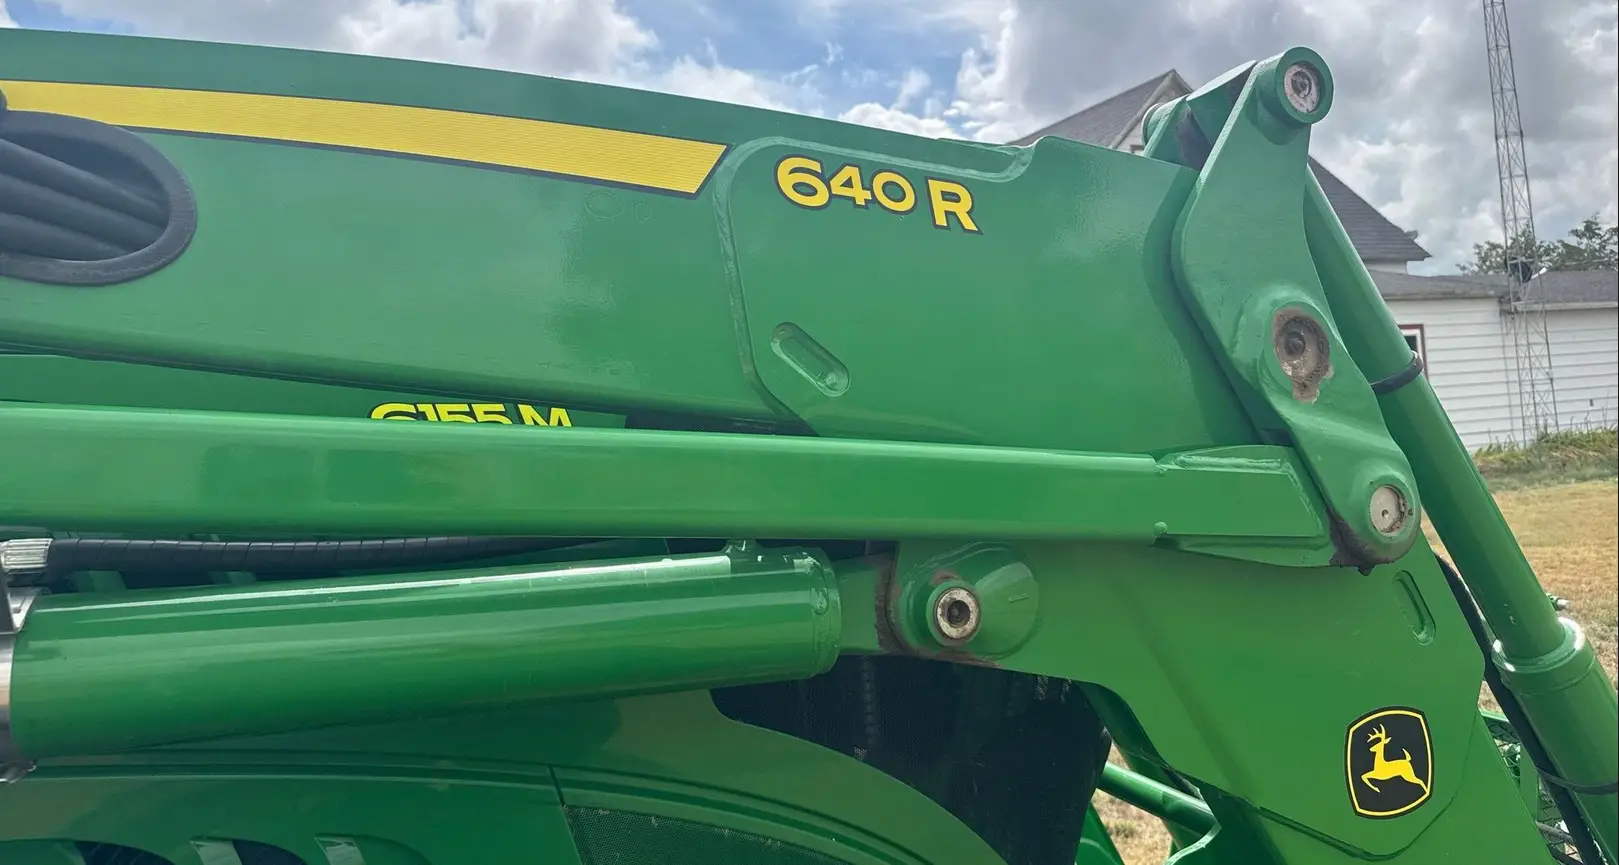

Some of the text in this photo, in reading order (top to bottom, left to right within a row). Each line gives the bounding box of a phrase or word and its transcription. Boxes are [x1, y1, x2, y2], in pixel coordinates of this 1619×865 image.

[775, 155, 981, 234] 640 R
[517, 403, 573, 427] M
